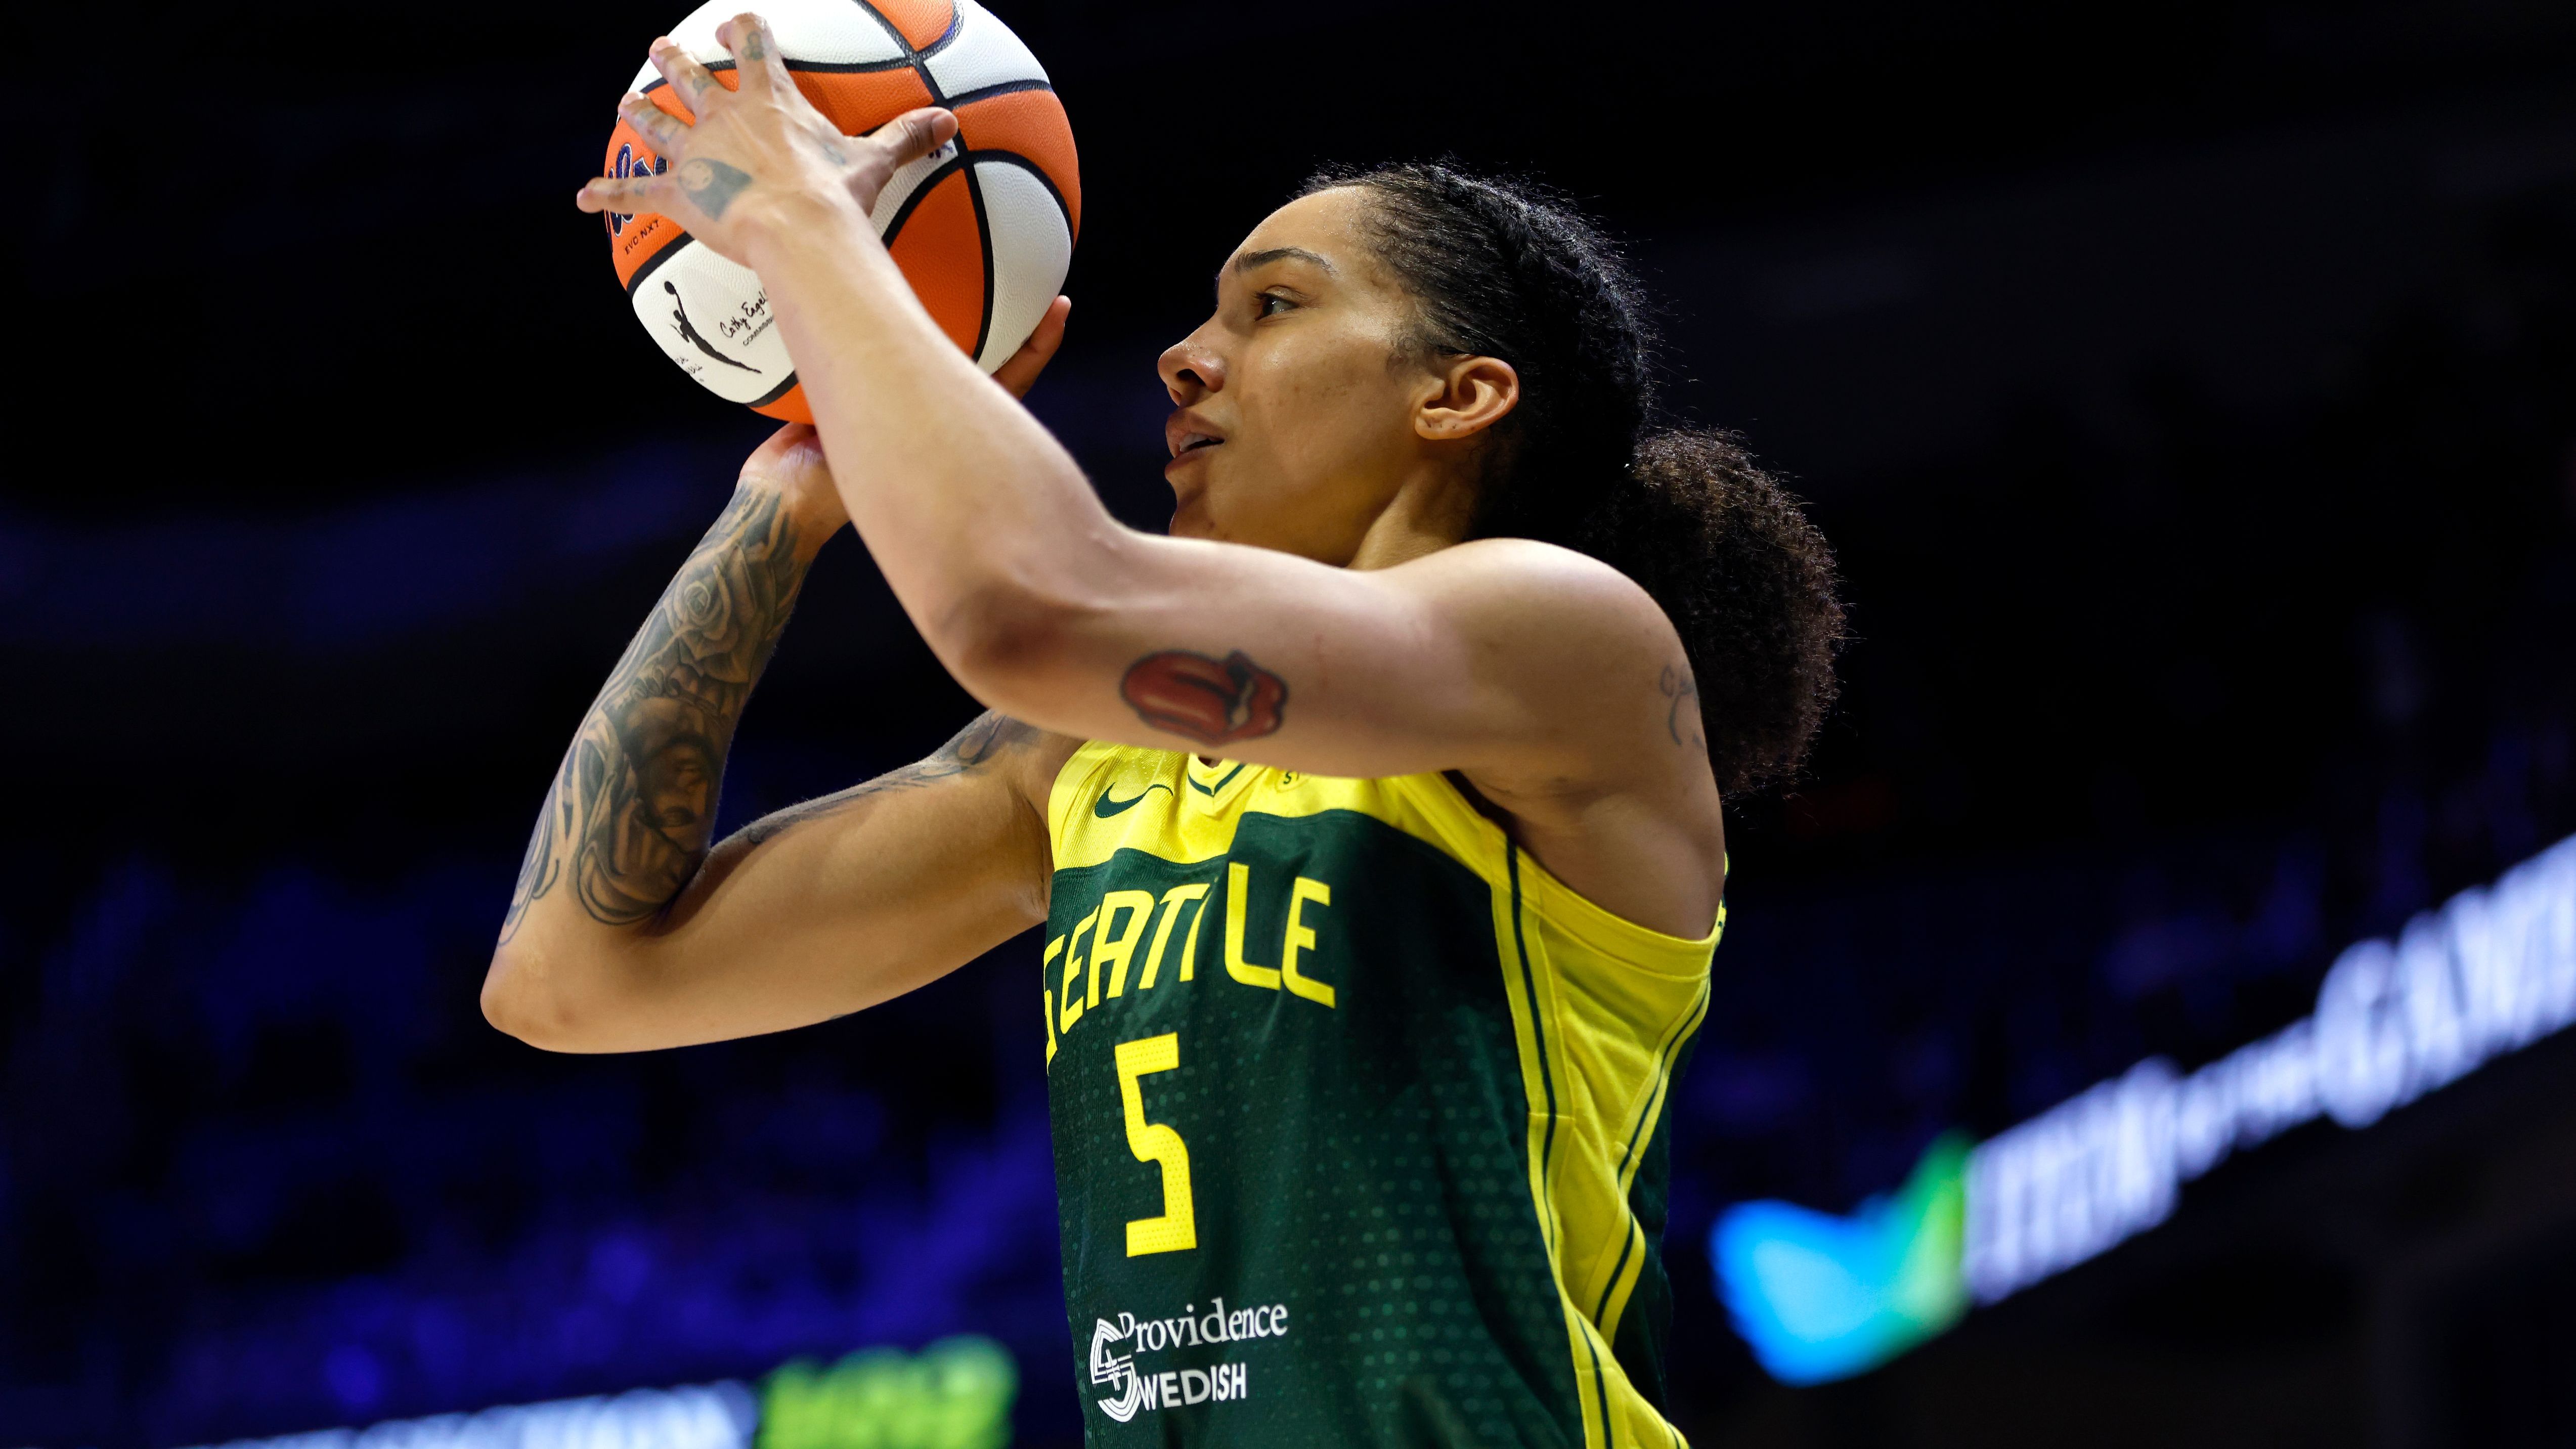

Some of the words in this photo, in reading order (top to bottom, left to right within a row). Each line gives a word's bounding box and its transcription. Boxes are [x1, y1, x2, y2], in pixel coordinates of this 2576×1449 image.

[624, 237, 639, 255] EVO
[640, 218, 660, 239] NXT
[741, 288, 766, 317] Engel
[1115, 1032, 1197, 1258] 5
[1117, 1296, 1289, 1353] Providence
